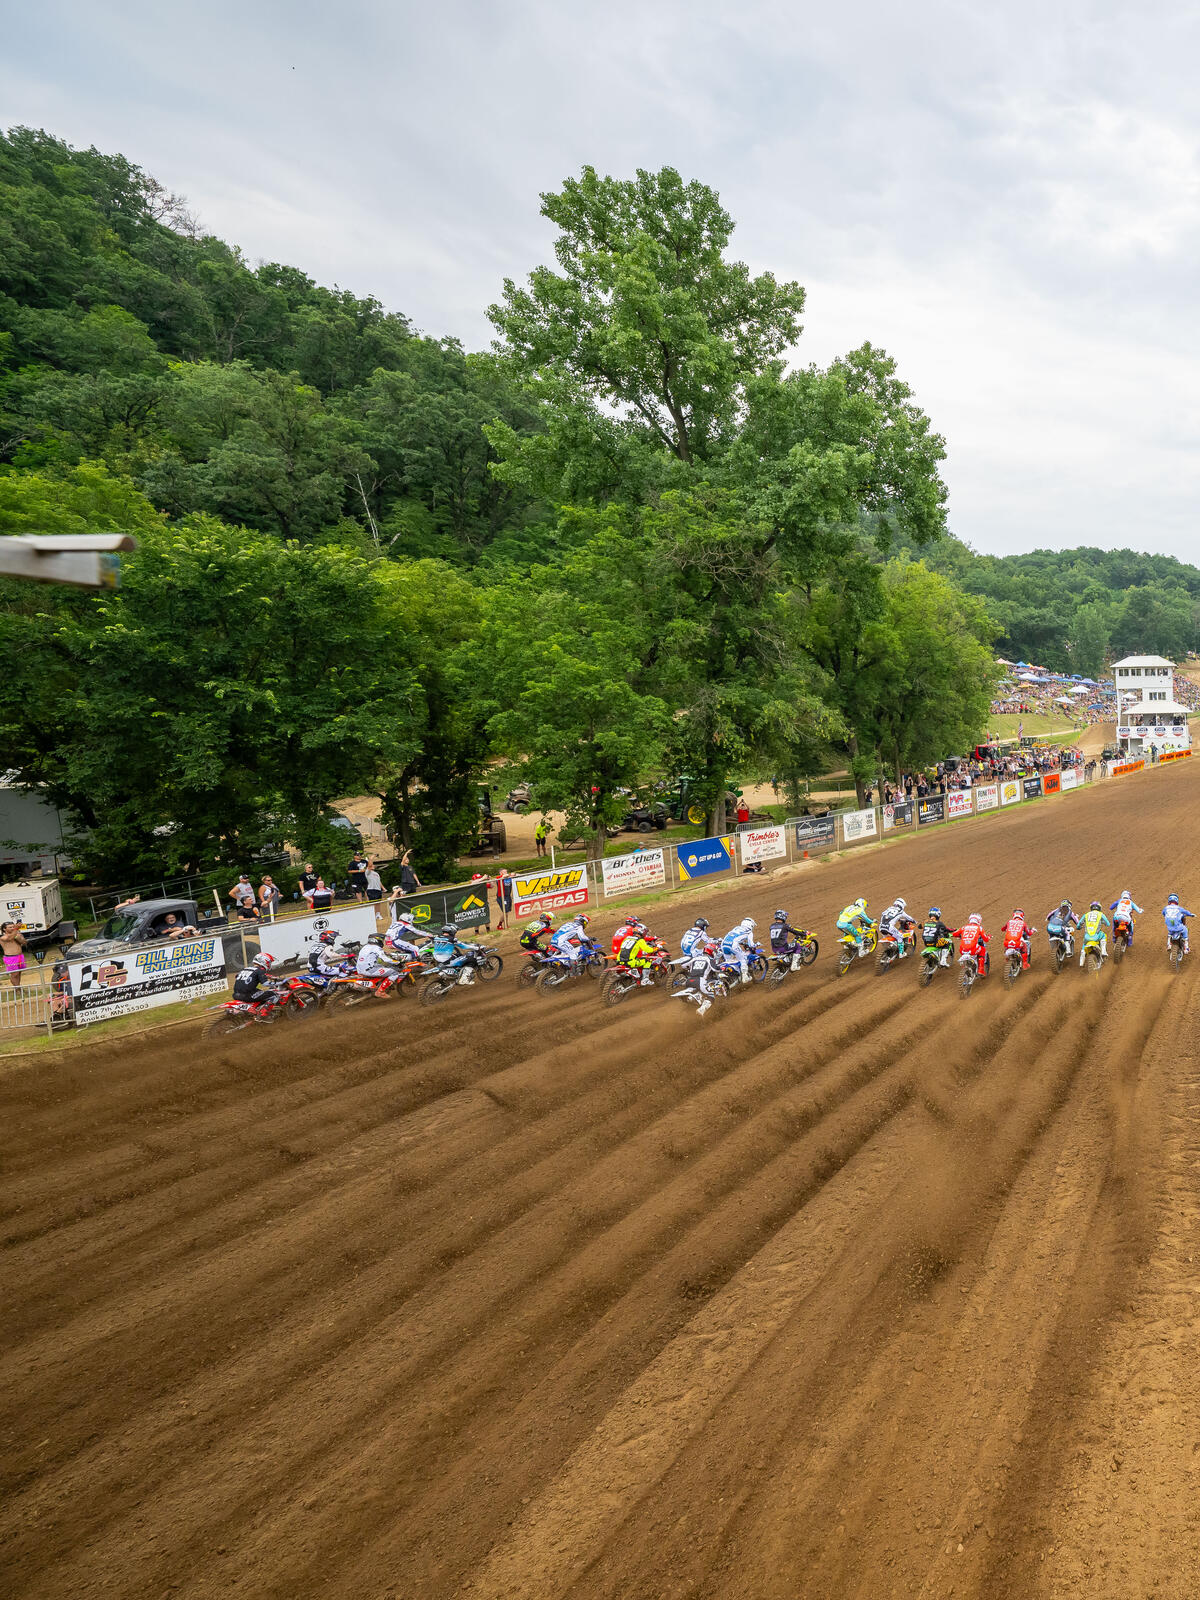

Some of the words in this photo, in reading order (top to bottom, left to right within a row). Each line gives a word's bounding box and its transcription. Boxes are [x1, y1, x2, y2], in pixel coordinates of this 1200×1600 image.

[1046, 781, 1058, 790] KTM
[747, 831, 780, 844] Trimble's
[644, 863, 662, 871] YAMAHA
[516, 871, 582, 898] VAITH
[7, 902, 25, 910] CAT
[518, 891, 586, 916] GASGAS
[455, 908, 485, 918] MIDWEST
[923, 927, 937, 937] 22
[963, 930, 977, 940] 26
[136, 950, 166, 967] BILL
[172, 940, 215, 959] BUNE
[142, 952, 214, 974] ENTERPRISES
[148, 963, 213, 979] www.billbune.com
[81, 990, 114, 1002] Cylinder
[116, 985, 143, 994] Boring
[154, 975, 185, 986] Sleeving
[194, 967, 221, 976] Porting
[85, 993, 132, 1008] Crankshaft
[135, 985, 173, 997] Rebuilding
[202, 973, 220, 982] Jobs
[126, 1003, 149, 1013] 55303
[80, 1010, 97, 1018] 2016
